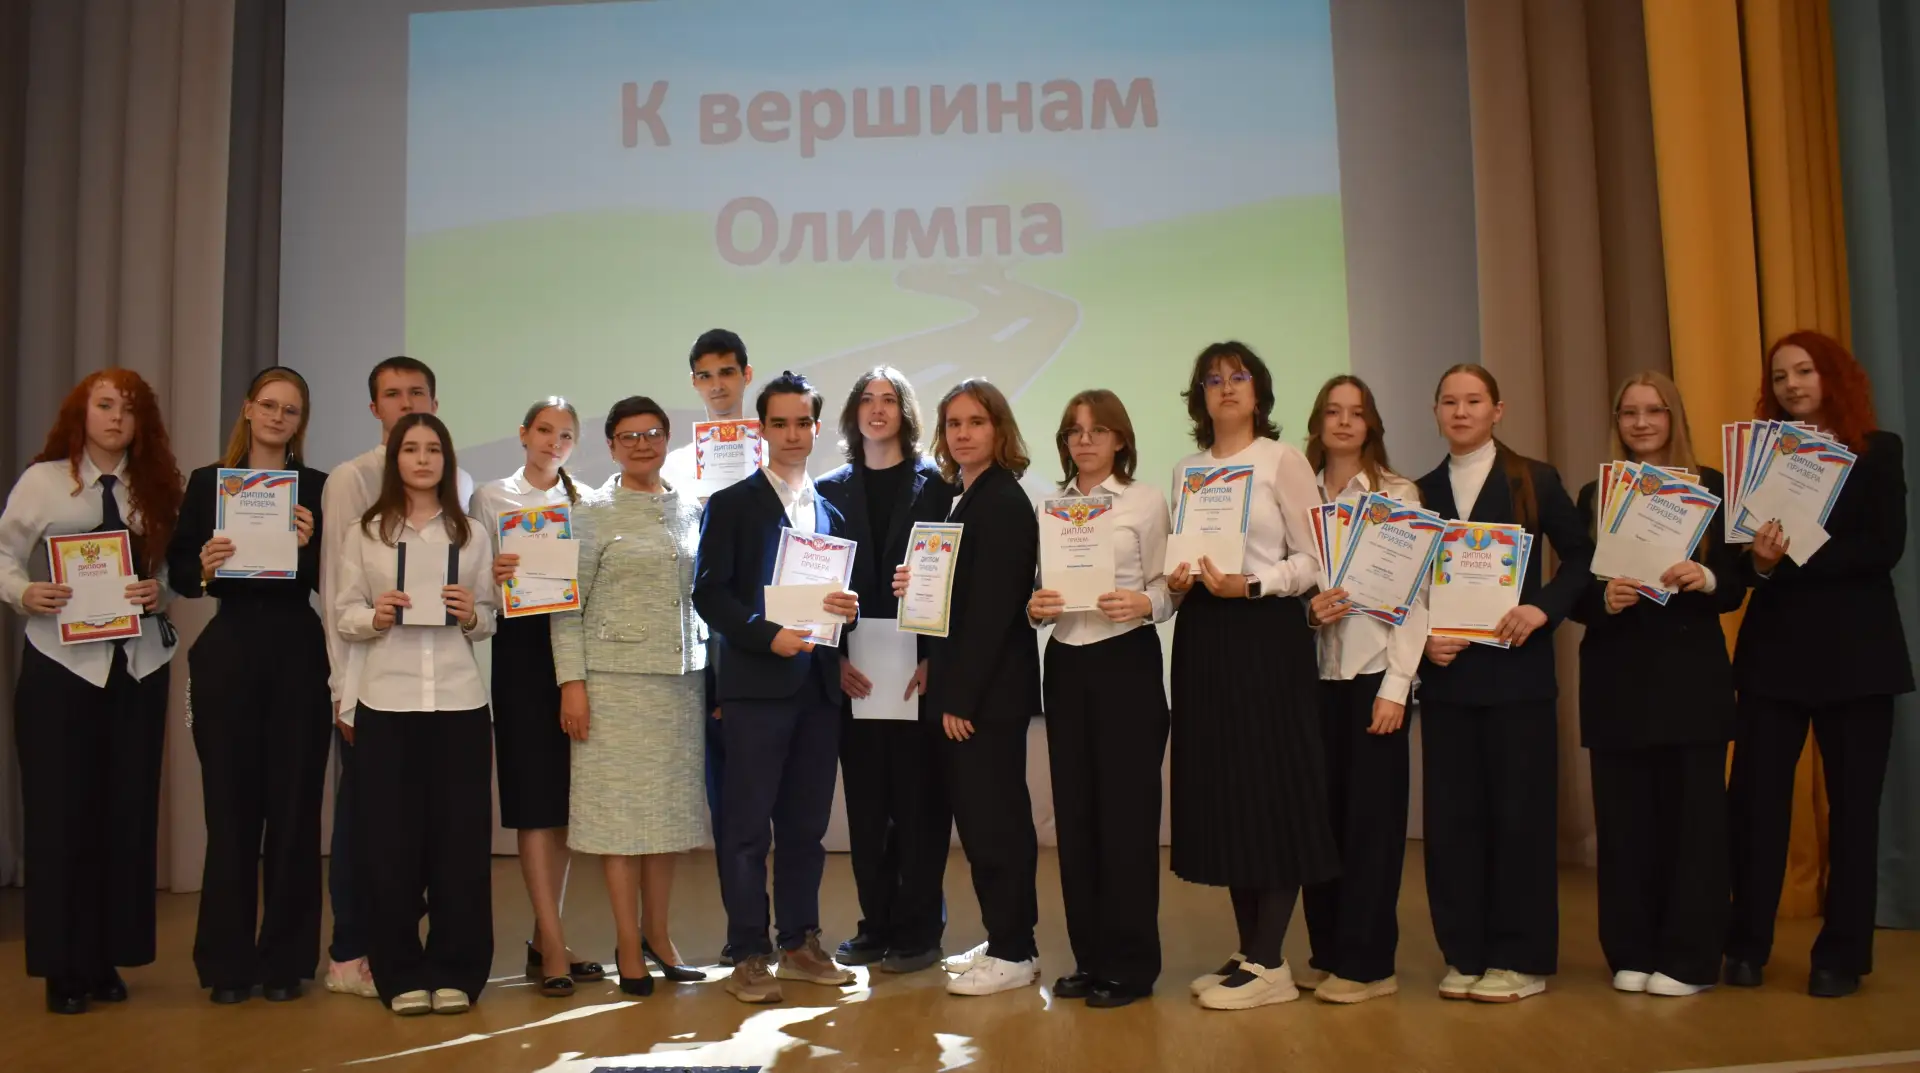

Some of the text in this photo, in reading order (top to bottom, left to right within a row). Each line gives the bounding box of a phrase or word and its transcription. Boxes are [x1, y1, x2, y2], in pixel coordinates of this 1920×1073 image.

[620, 76, 1160, 158] К вершинам
[714, 195, 1064, 266] Олимпа
[714, 444, 743, 452] ДИПЛОМ
[1790, 454, 1825, 474] ДИПЛОМ
[1787, 462, 1821, 483] ПРИЗЕРА
[240, 500, 276, 508] ПРИЗЕРА
[1651, 495, 1688, 516] ДИПЛОМ
[1646, 503, 1682, 525] ПРИЗЕРА
[1061, 526, 1095, 536] ДИПЛОМ
[1381, 523, 1417, 542] ДИПЛОМ
[1377, 531, 1413, 550] ПРИЗЕРА
[803, 552, 831, 562] ДИПЛОМ
[1461, 551, 1492, 560] ДИПЛОМ
[78, 563, 107, 571] ДИПЛОМ
[801, 560, 829, 572] ПРИЗЕРА
[1460, 561, 1492, 570] ПРИЗЕРА
